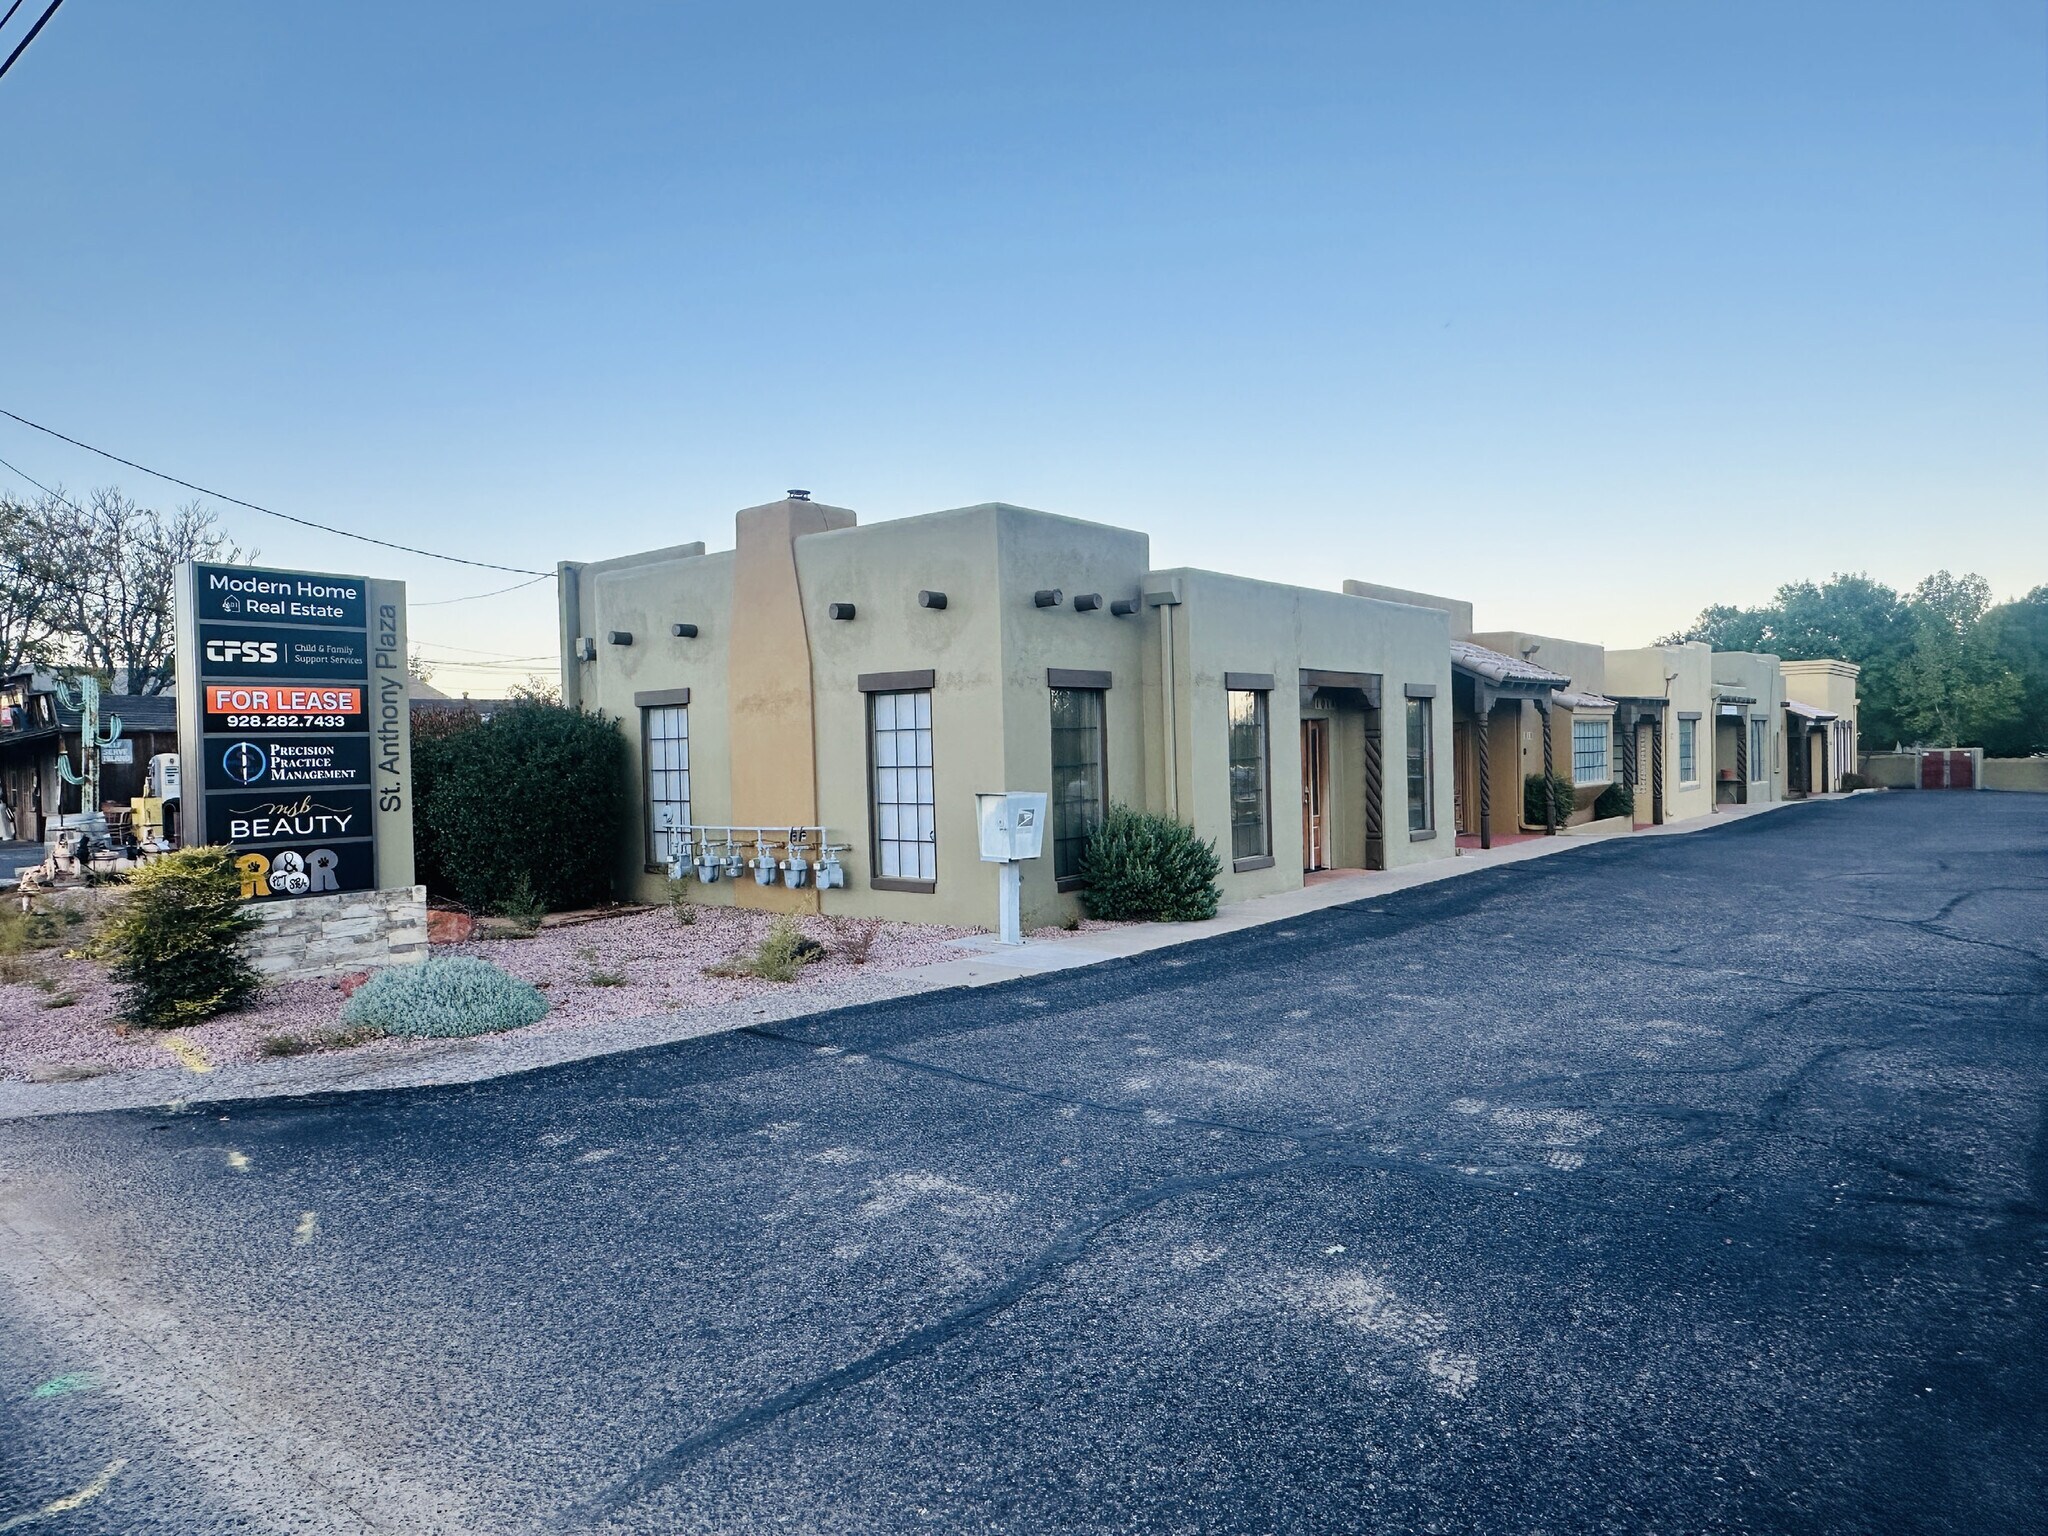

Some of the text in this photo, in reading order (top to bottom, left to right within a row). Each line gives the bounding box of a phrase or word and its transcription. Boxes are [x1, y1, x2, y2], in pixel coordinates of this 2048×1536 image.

[209, 574, 358, 600] Modern Home
[246, 599, 344, 618] Real Estate
[206, 640, 278, 664] CFSS
[294, 643, 354, 655] Child & Family
[294, 654, 363, 665] Support Services
[215, 689, 354, 711] FOR LEASE
[375, 604, 403, 812] St. Anthony Plaza
[226, 715, 346, 728] 928.282.7433
[230, 814, 353, 839] BEAUTY
